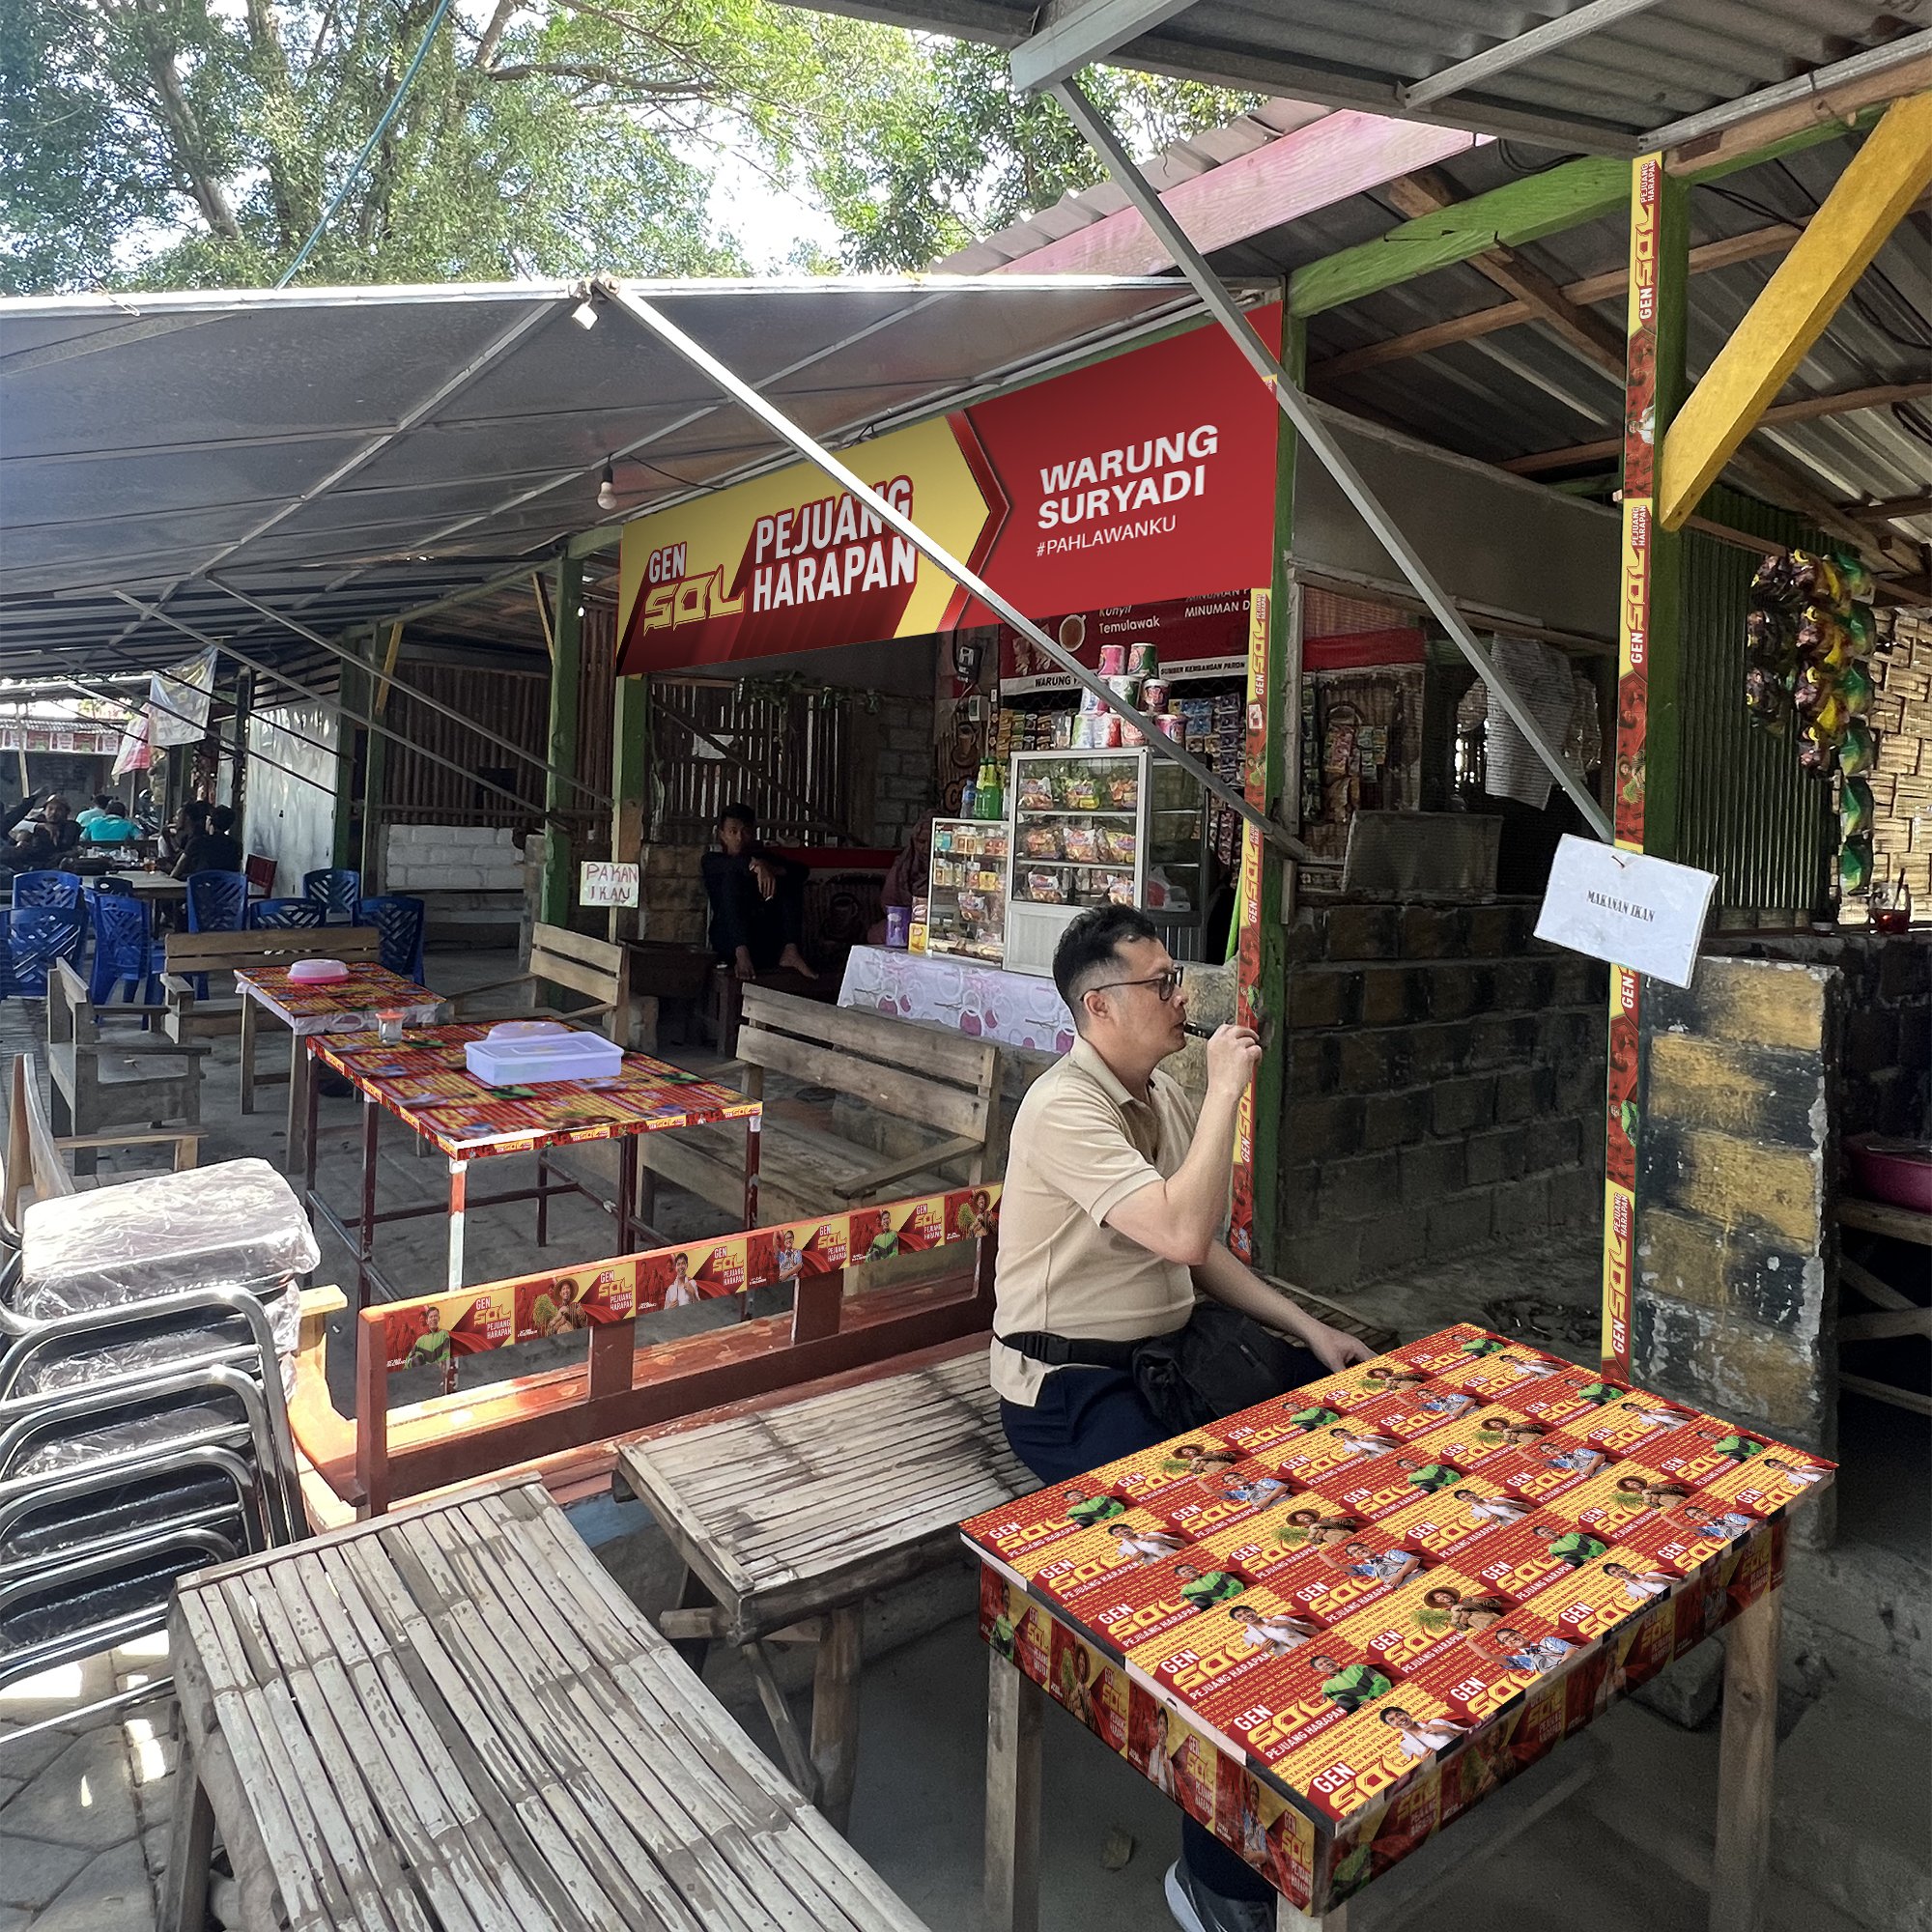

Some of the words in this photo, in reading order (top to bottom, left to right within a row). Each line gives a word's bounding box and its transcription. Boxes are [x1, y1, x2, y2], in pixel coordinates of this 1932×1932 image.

[1640, 288, 1652, 320] GEN
[1039, 424, 1218, 496] WARUNG
[1037, 465, 1206, 529] SURYADI
[1036, 515, 1177, 556] #PAHLAWANKU
[648, 543, 686, 583] GEN
[753, 536, 917, 612] HARAPAN
[1184, 601, 1239, 618] MINUMAN
[1099, 616, 1160, 634] Temulawak
[1631, 632, 1643, 663] GEN
[1036, 676, 1070, 688] WARUNG
[586, 864, 638, 883] PAKAN
[590, 886, 631, 901] IKAN
[1248, 900, 1258, 923] GEN
[1586, 890, 1628, 915] MAKANAN
[1631, 904, 1656, 923] IKAN
[1621, 976, 1634, 1009] GEN
[1241, 1136, 1251, 1163] GEN
[1613, 1319, 1625, 1354] GEN
[1525, 1401, 1550, 1412] GEN
[1228, 1426, 1256, 1438] GEN
[1590, 1427, 1615, 1439] GEN
[1441, 1442, 1468, 1455] GEN
[1282, 1454, 1312, 1468] GEN
[1662, 1457, 1688, 1470] GEN
[1118, 1472, 1147, 1486] GEN
[1507, 1471, 1535, 1486] GEN
[1344, 1487, 1374, 1502] GEN
[1737, 1488, 1764, 1502] GEN
[1172, 1504, 1203, 1520] GEN
[1579, 1507, 1607, 1521] GEN
[989, 1520, 1023, 1538] GEN
[1408, 1520, 1439, 1538] GEN
[1232, 1543, 1263, 1559] GEN
[1658, 1541, 1688, 1558] GEN
[1039, 1558, 1076, 1577] GEN
[1483, 1560, 1514, 1578] GEN
[1296, 1580, 1330, 1600] GEN
[1098, 1603, 1134, 1623] GEN
[1561, 1601, 1596, 1622] GEN
[1371, 1629, 1405, 1649] GEN
[1161, 1648, 1202, 1672] GEN
[1400, 1650, 1437, 1673] PEJUANG
[1431, 1631, 1467, 1654] HARAPAN
[1187, 1673, 1234, 1700] PEJUANG
[1229, 1651, 1273, 1677] HARAPAN
[1451, 1676, 1488, 1700] GEN
[1234, 1703, 1274, 1729] GEN
[1264, 1729, 1310, 1760] PEJUANG
[1302, 1705, 1348, 1735] HARAPAN
[1313, 1760, 1358, 1792] GEN
